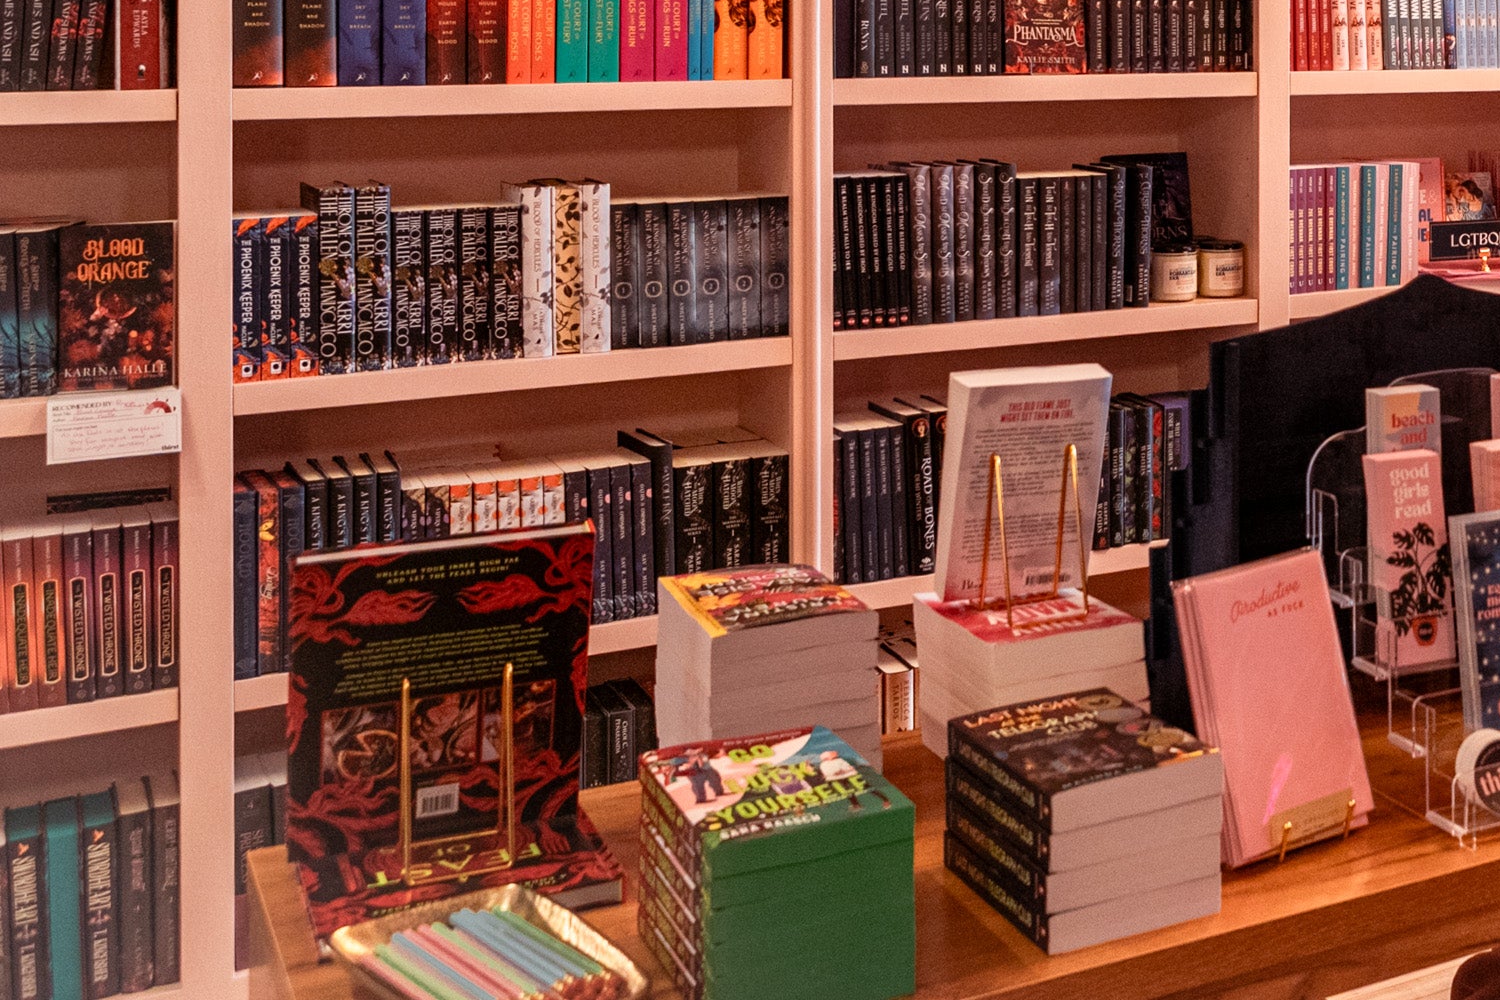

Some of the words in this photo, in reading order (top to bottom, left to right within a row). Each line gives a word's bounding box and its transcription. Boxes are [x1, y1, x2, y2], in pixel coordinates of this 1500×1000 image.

[1006, 24, 1085, 47] PHANTASMA
[320, 195, 338, 218] THE
[338, 195, 352, 237] THRONE
[82, 237, 145, 262] BLOOD
[320, 221, 338, 260] FALLEN
[338, 240, 351, 258] OF
[77, 260, 151, 285] ORANGE
[271, 245, 281, 289] PHOENIX
[268, 290, 282, 321] KEEPER
[337, 300, 352, 335] KERRI
[64, 366, 118, 378] KARINA
[122, 364, 167, 376] HALLE
[1391, 409, 1435, 429] beach
[922, 457, 932, 494] ROAD
[1389, 463, 1430, 487] good
[1392, 482, 1430, 507] girls
[1394, 500, 1432, 519] read
[924, 506, 934, 551] BONES
[1231, 580, 1299, 623] Productive
[134, 626, 143, 663] THRONE
[1016, 697, 1079, 716] NIGHT
[728, 744, 774, 764] GO
[716, 773, 867, 824] YOURSELF
